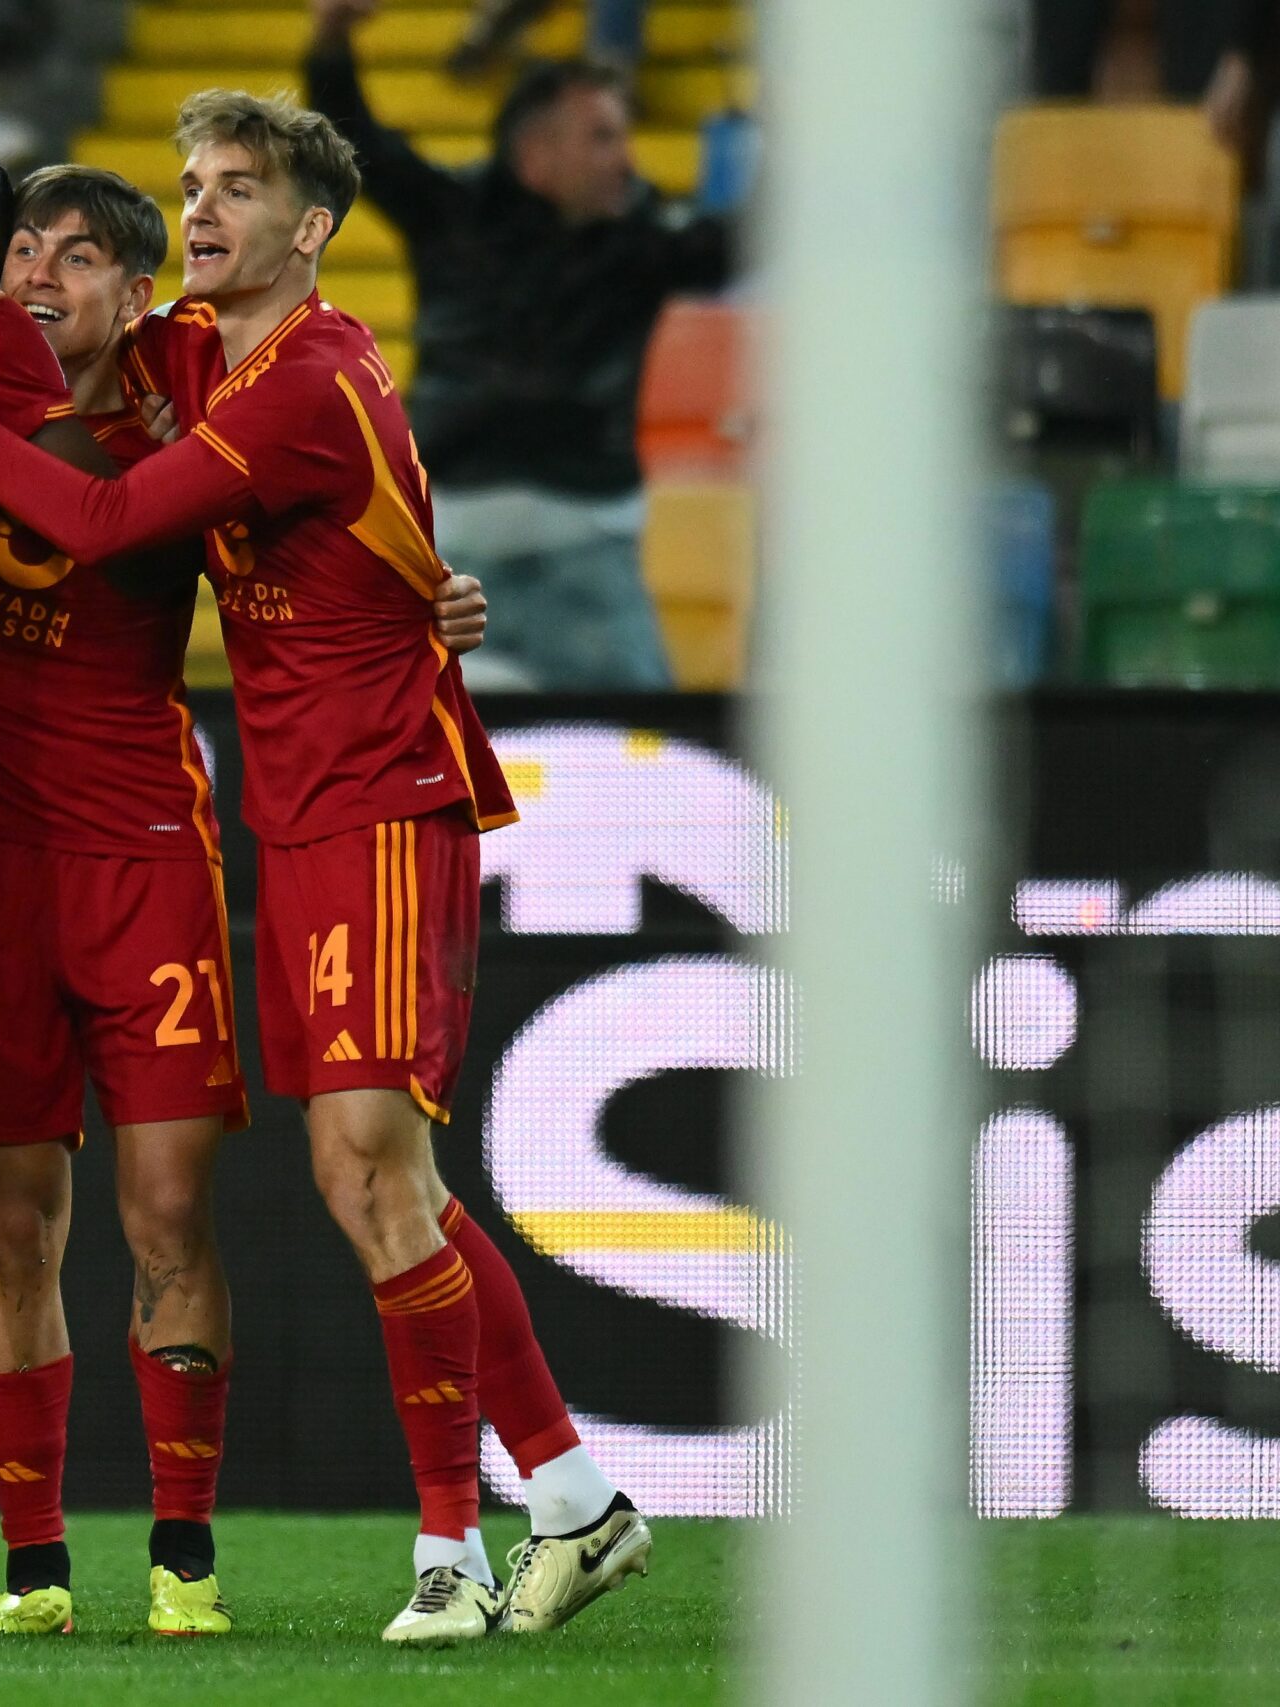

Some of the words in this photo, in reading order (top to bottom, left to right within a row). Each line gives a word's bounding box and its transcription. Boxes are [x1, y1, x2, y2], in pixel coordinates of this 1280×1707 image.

[219, 589, 293, 621] SESON
[148, 959, 229, 1047] 21
[308, 923, 353, 1017] 14
